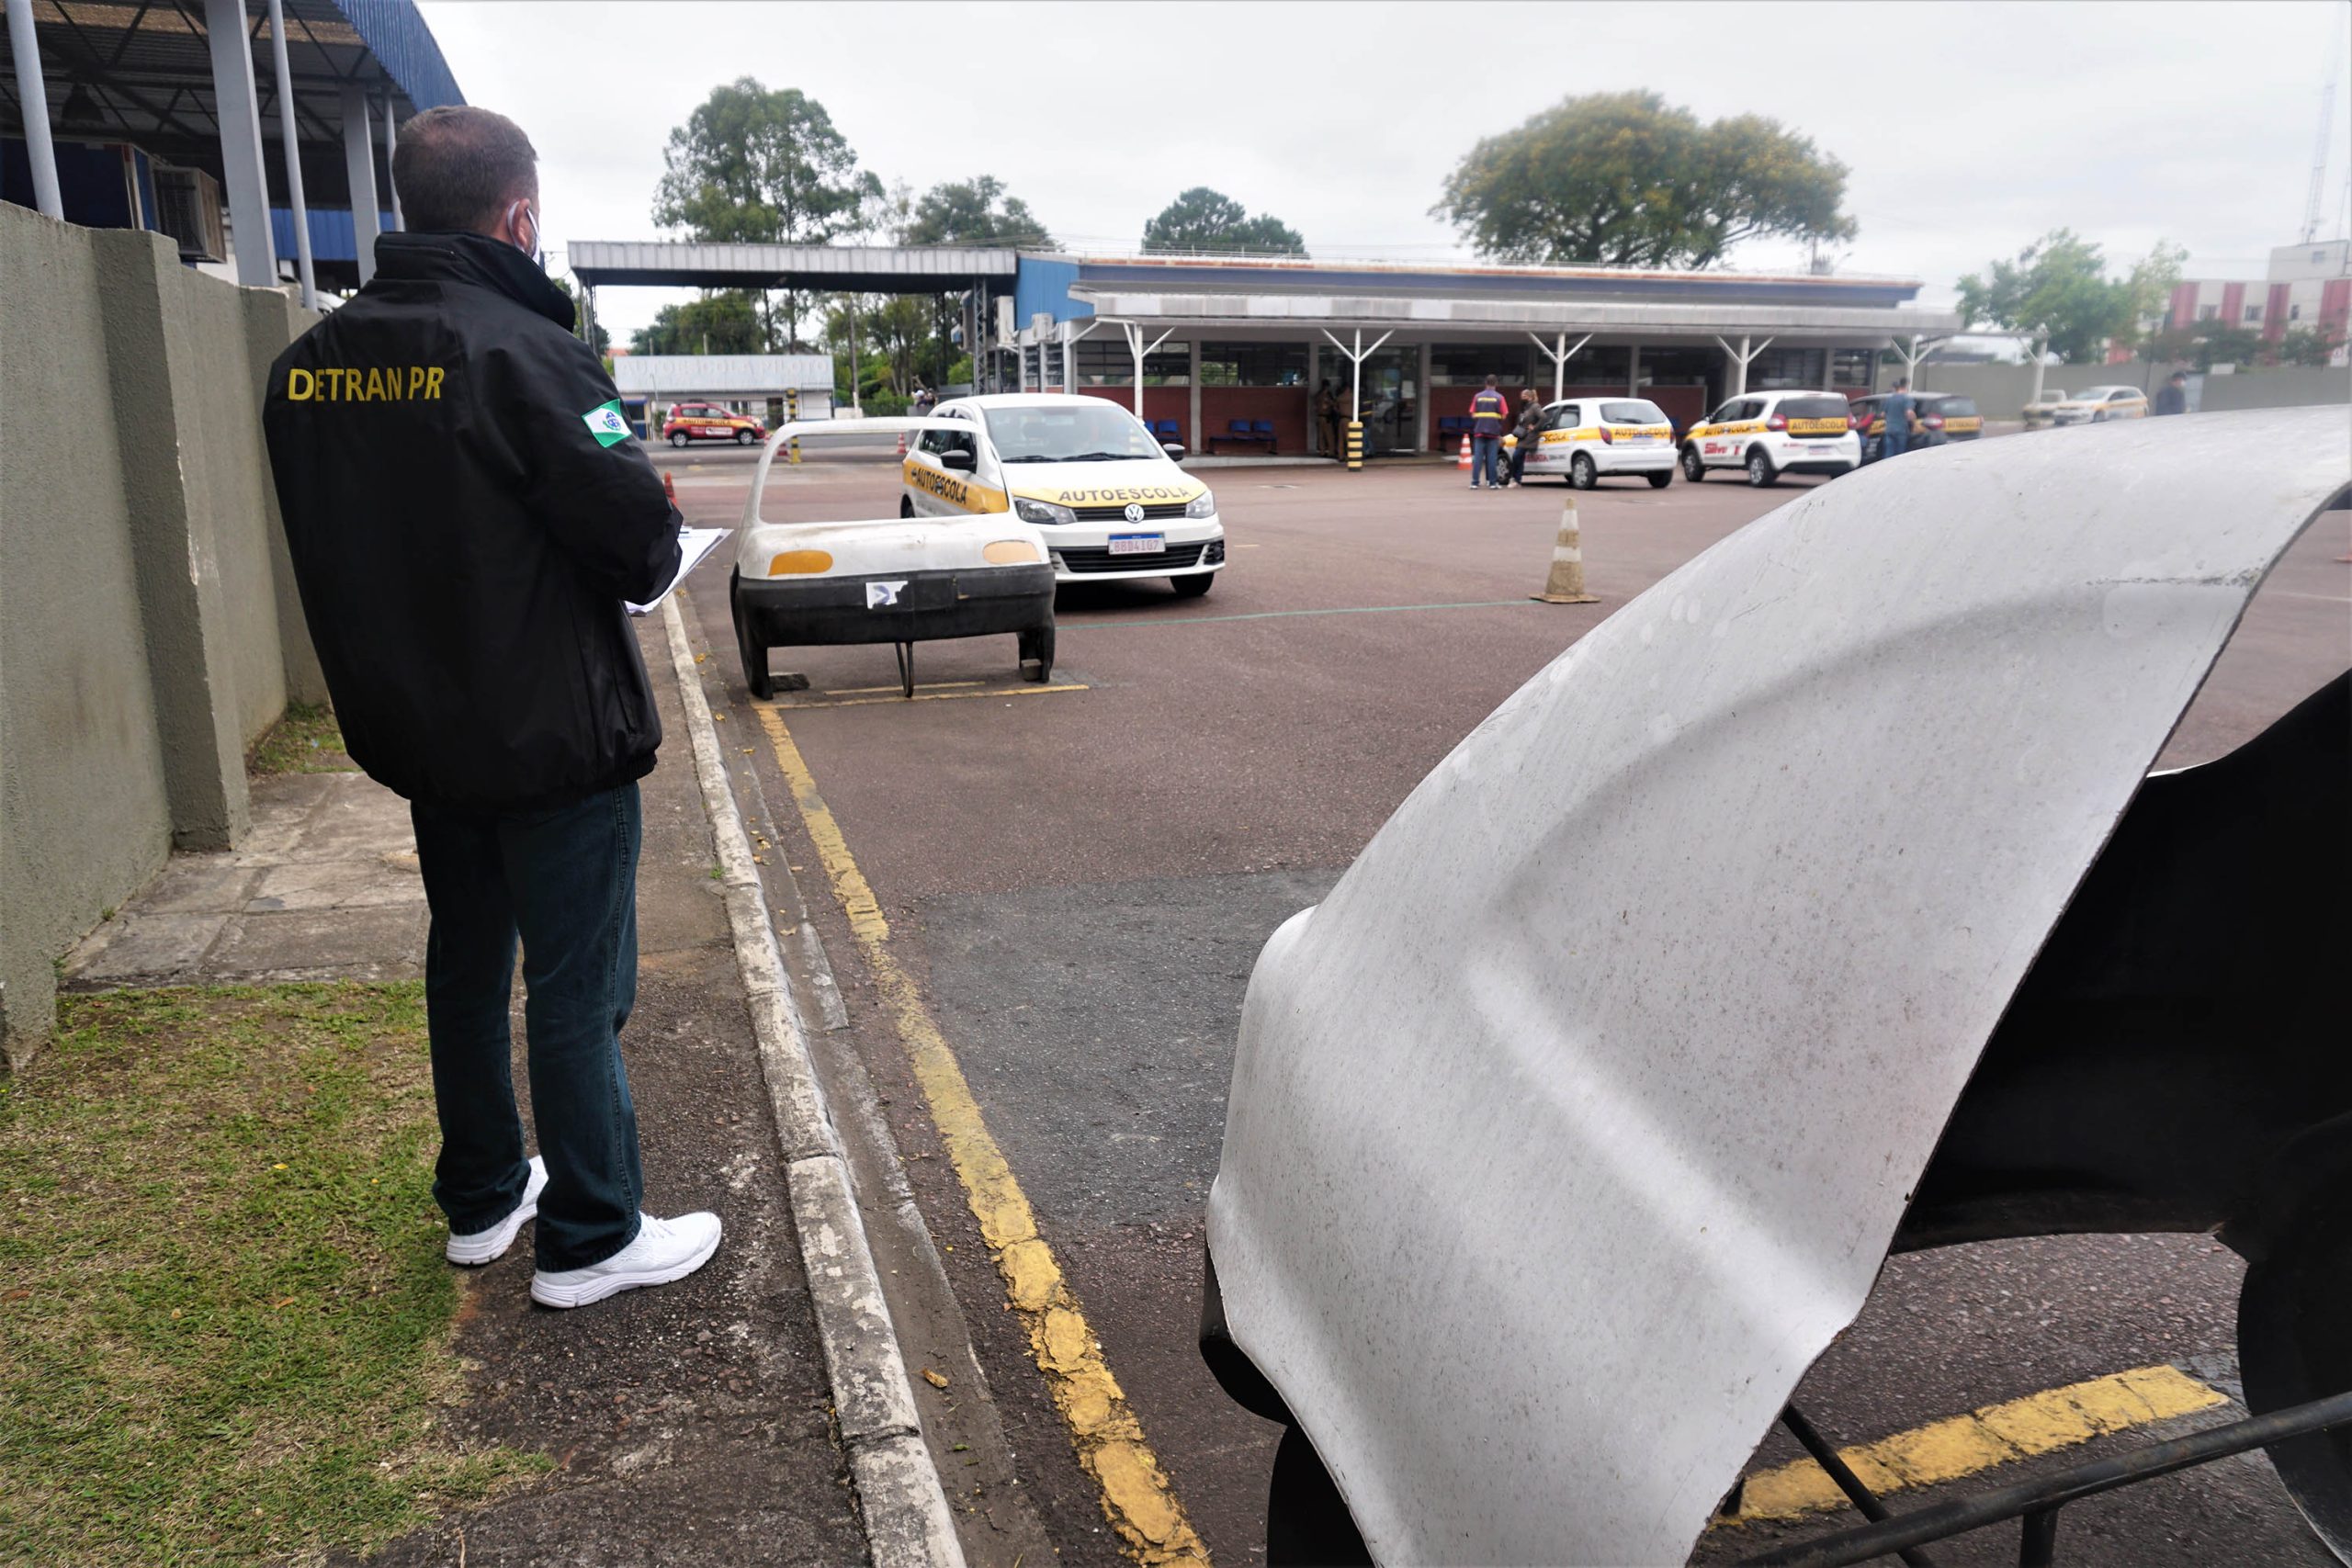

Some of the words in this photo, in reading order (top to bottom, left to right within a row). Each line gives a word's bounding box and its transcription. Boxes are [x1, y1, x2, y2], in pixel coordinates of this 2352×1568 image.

[288, 367, 402, 401] DETRAN
[408, 367, 445, 400] PR
[1792, 420, 1846, 430] AUTOESCOLA
[916, 467, 968, 505] AUTOESCOLA
[1058, 487, 1193, 502] AUTOESCOLA
